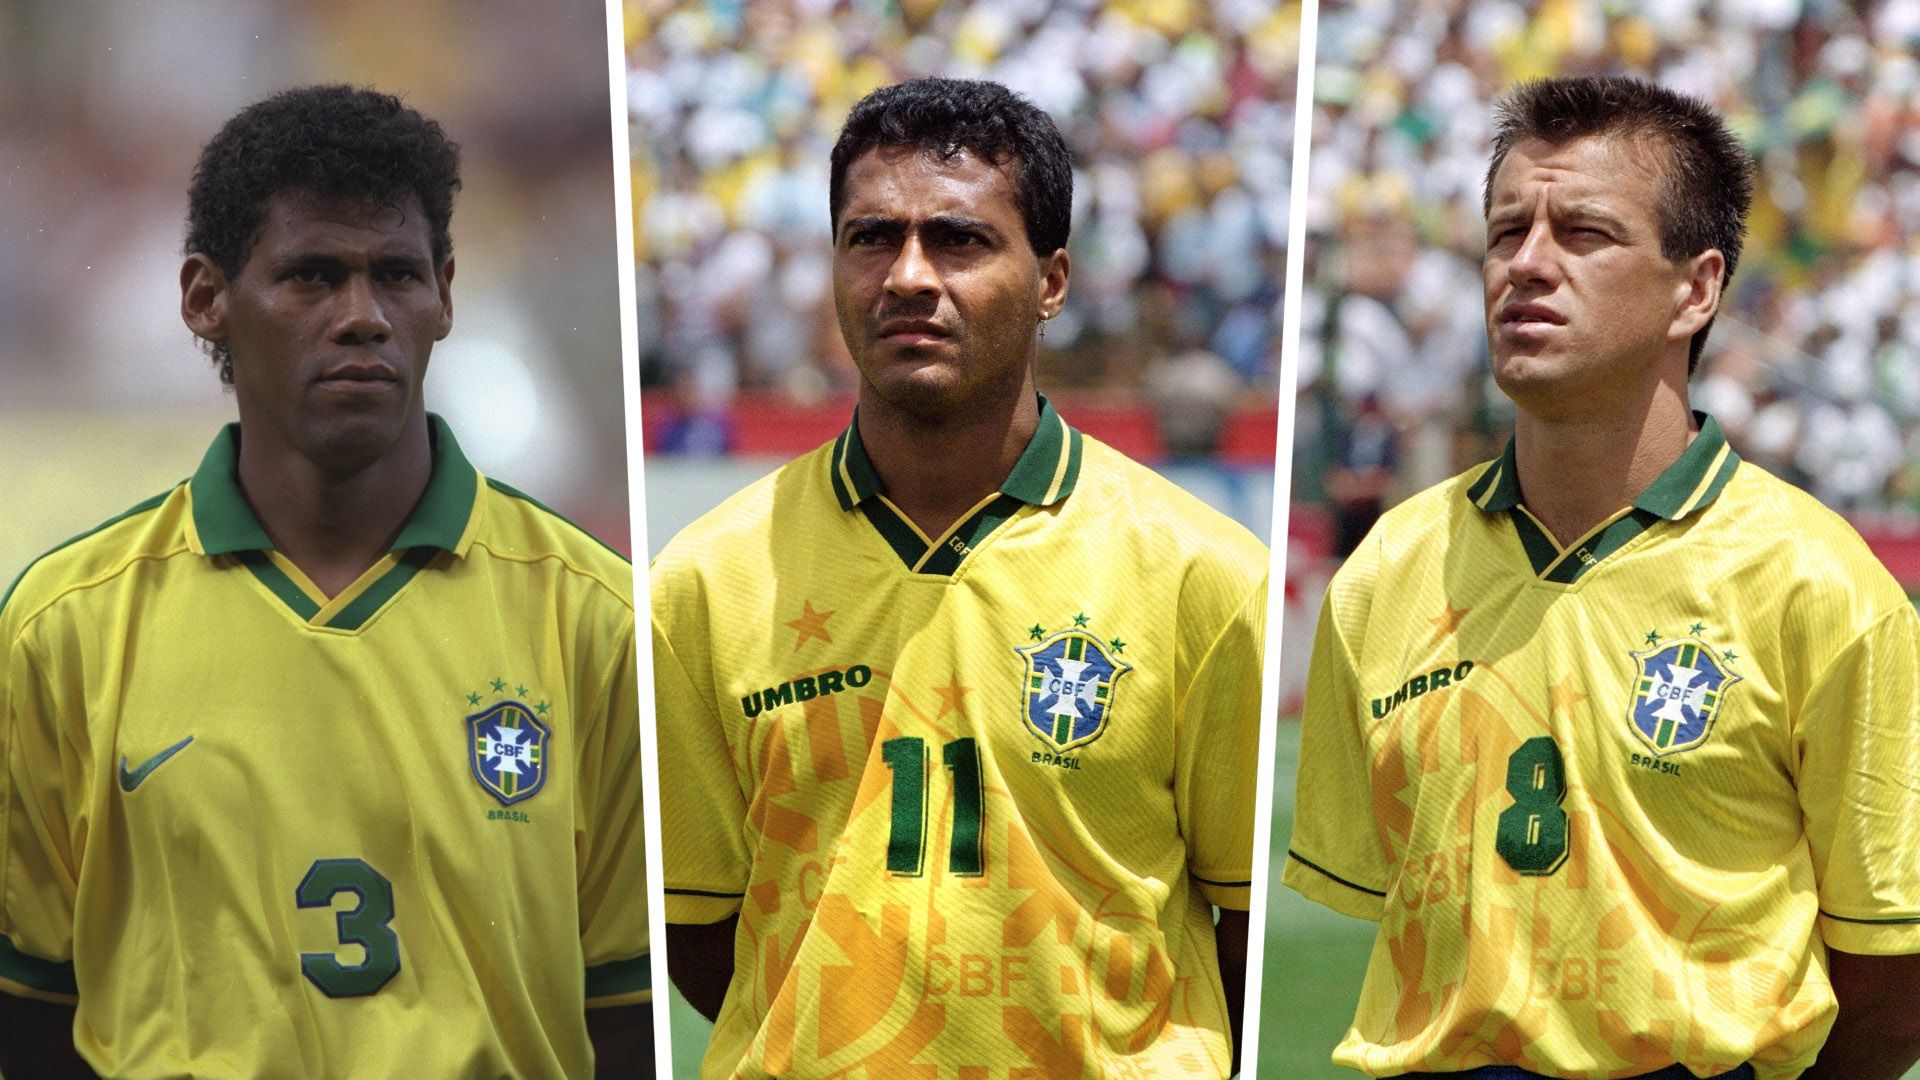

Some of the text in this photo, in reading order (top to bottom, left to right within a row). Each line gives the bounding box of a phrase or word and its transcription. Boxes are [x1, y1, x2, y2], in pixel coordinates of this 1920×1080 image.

[741, 664, 872, 718] UMBRO
[1049, 678, 1085, 697] CBF
[1371, 660, 1474, 719] UMBRO
[1656, 683, 1693, 702] CBF
[494, 742, 524, 758] CBF
[1031, 751, 1081, 770] BRASIL
[1630, 752, 1681, 777] BRASIL
[487, 809, 530, 823] BRASIL
[882, 736, 986, 879] 11
[1495, 736, 1571, 877] 8
[295, 857, 402, 999] 3
[924, 952, 1029, 998] CBF
[1530, 957, 1622, 1002] CBF
